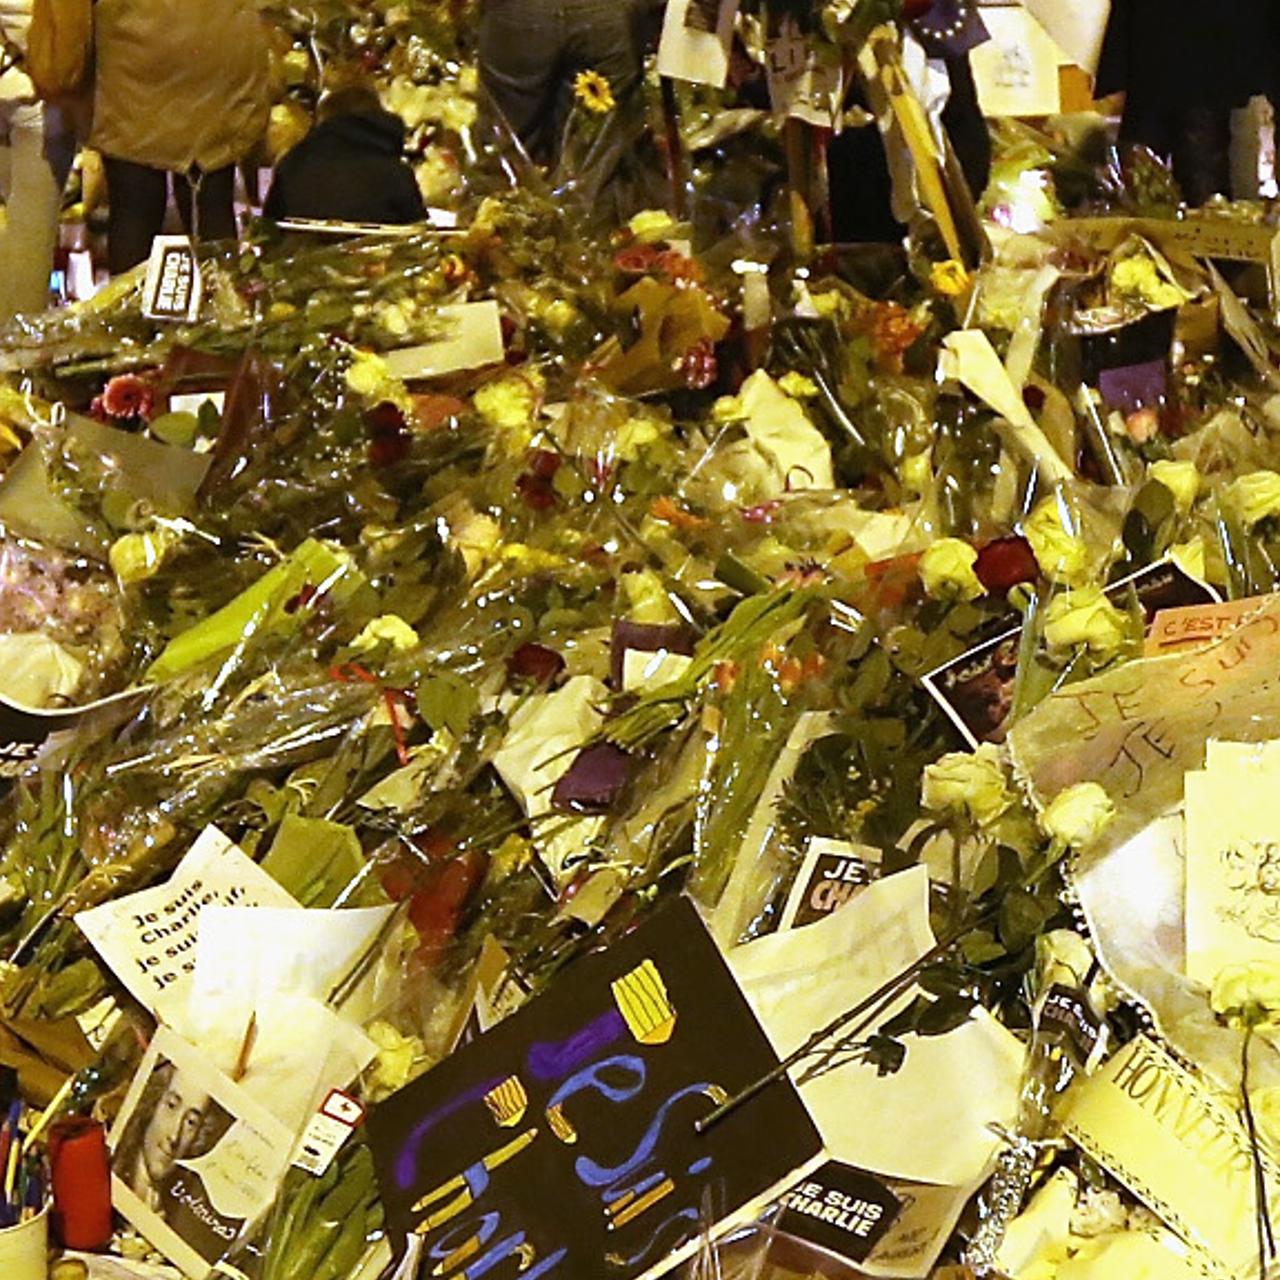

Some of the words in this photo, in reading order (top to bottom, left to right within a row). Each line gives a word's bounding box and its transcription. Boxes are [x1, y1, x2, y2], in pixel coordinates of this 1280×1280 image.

[823, 859, 864, 882] JE
[163, 879, 203, 914] suis
[140, 890, 220, 945] Charlie,
[166, 930, 198, 959] sui
[826, 1190, 884, 1220] SUIS
